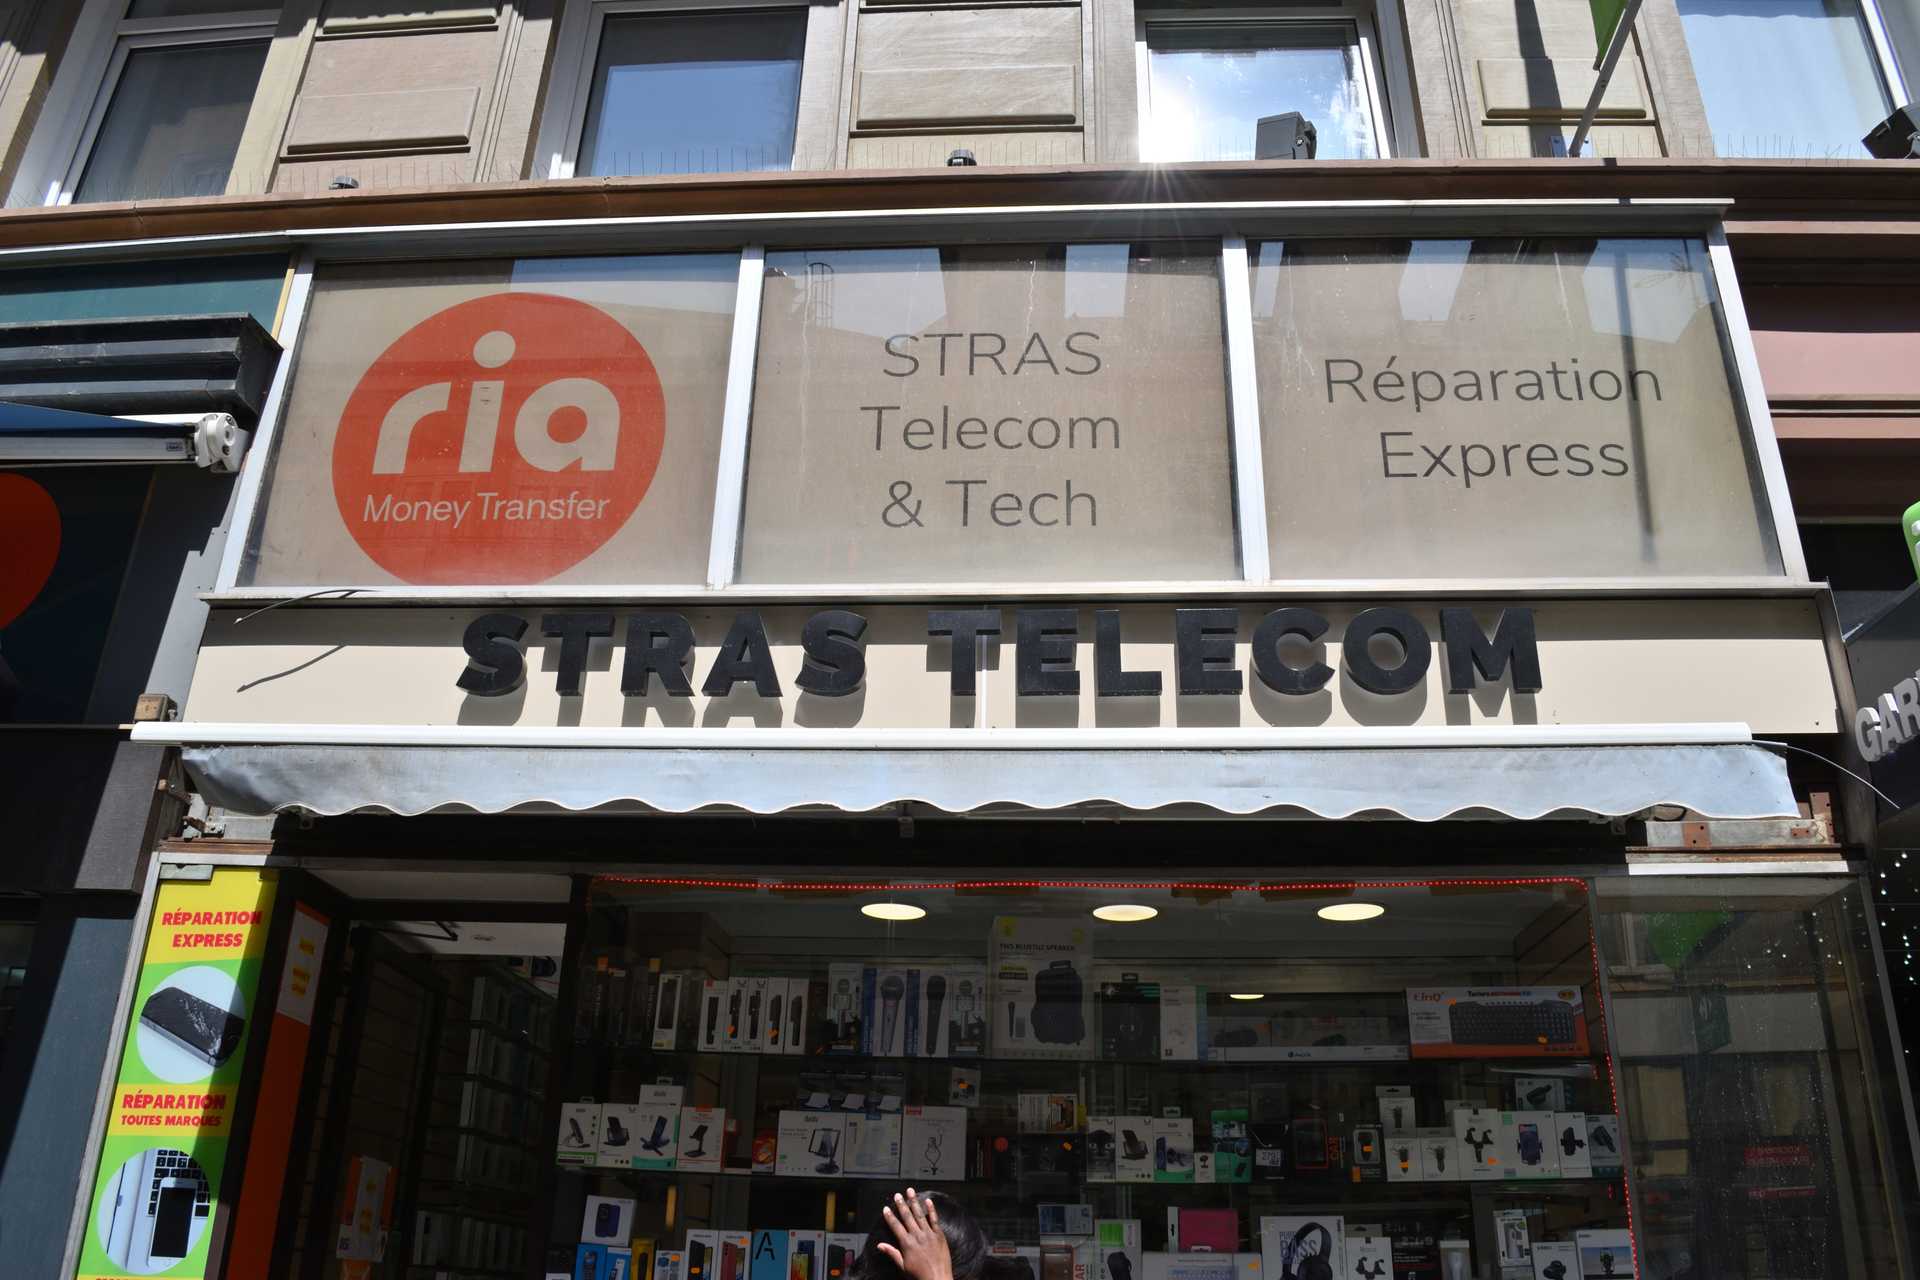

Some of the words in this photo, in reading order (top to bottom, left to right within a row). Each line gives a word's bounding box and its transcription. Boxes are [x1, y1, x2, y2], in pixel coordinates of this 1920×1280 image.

[883, 332, 1101, 377] STRAS
[372, 330, 620, 474] ria
[1324, 355, 1662, 413] Réparation
[860, 405, 1120, 450] Telecom
[1380, 431, 1629, 488] Express
[363, 494, 472, 528] Money
[477, 491, 611, 520] Transfer
[882, 480, 924, 527] &
[945, 480, 1097, 527] Tech
[456, 609, 867, 697] STRAS
[927, 607, 1543, 696] TELECOM
[1855, 670, 1920, 762] GAR
[162, 908, 263, 926] RÉPARATION
[172, 933, 244, 948] EXPRESS
[121, 1115, 162, 1126] TOUTES
[165, 1115, 222, 1127] MARQUES
[122, 1089, 226, 1109] RÉPARATION
